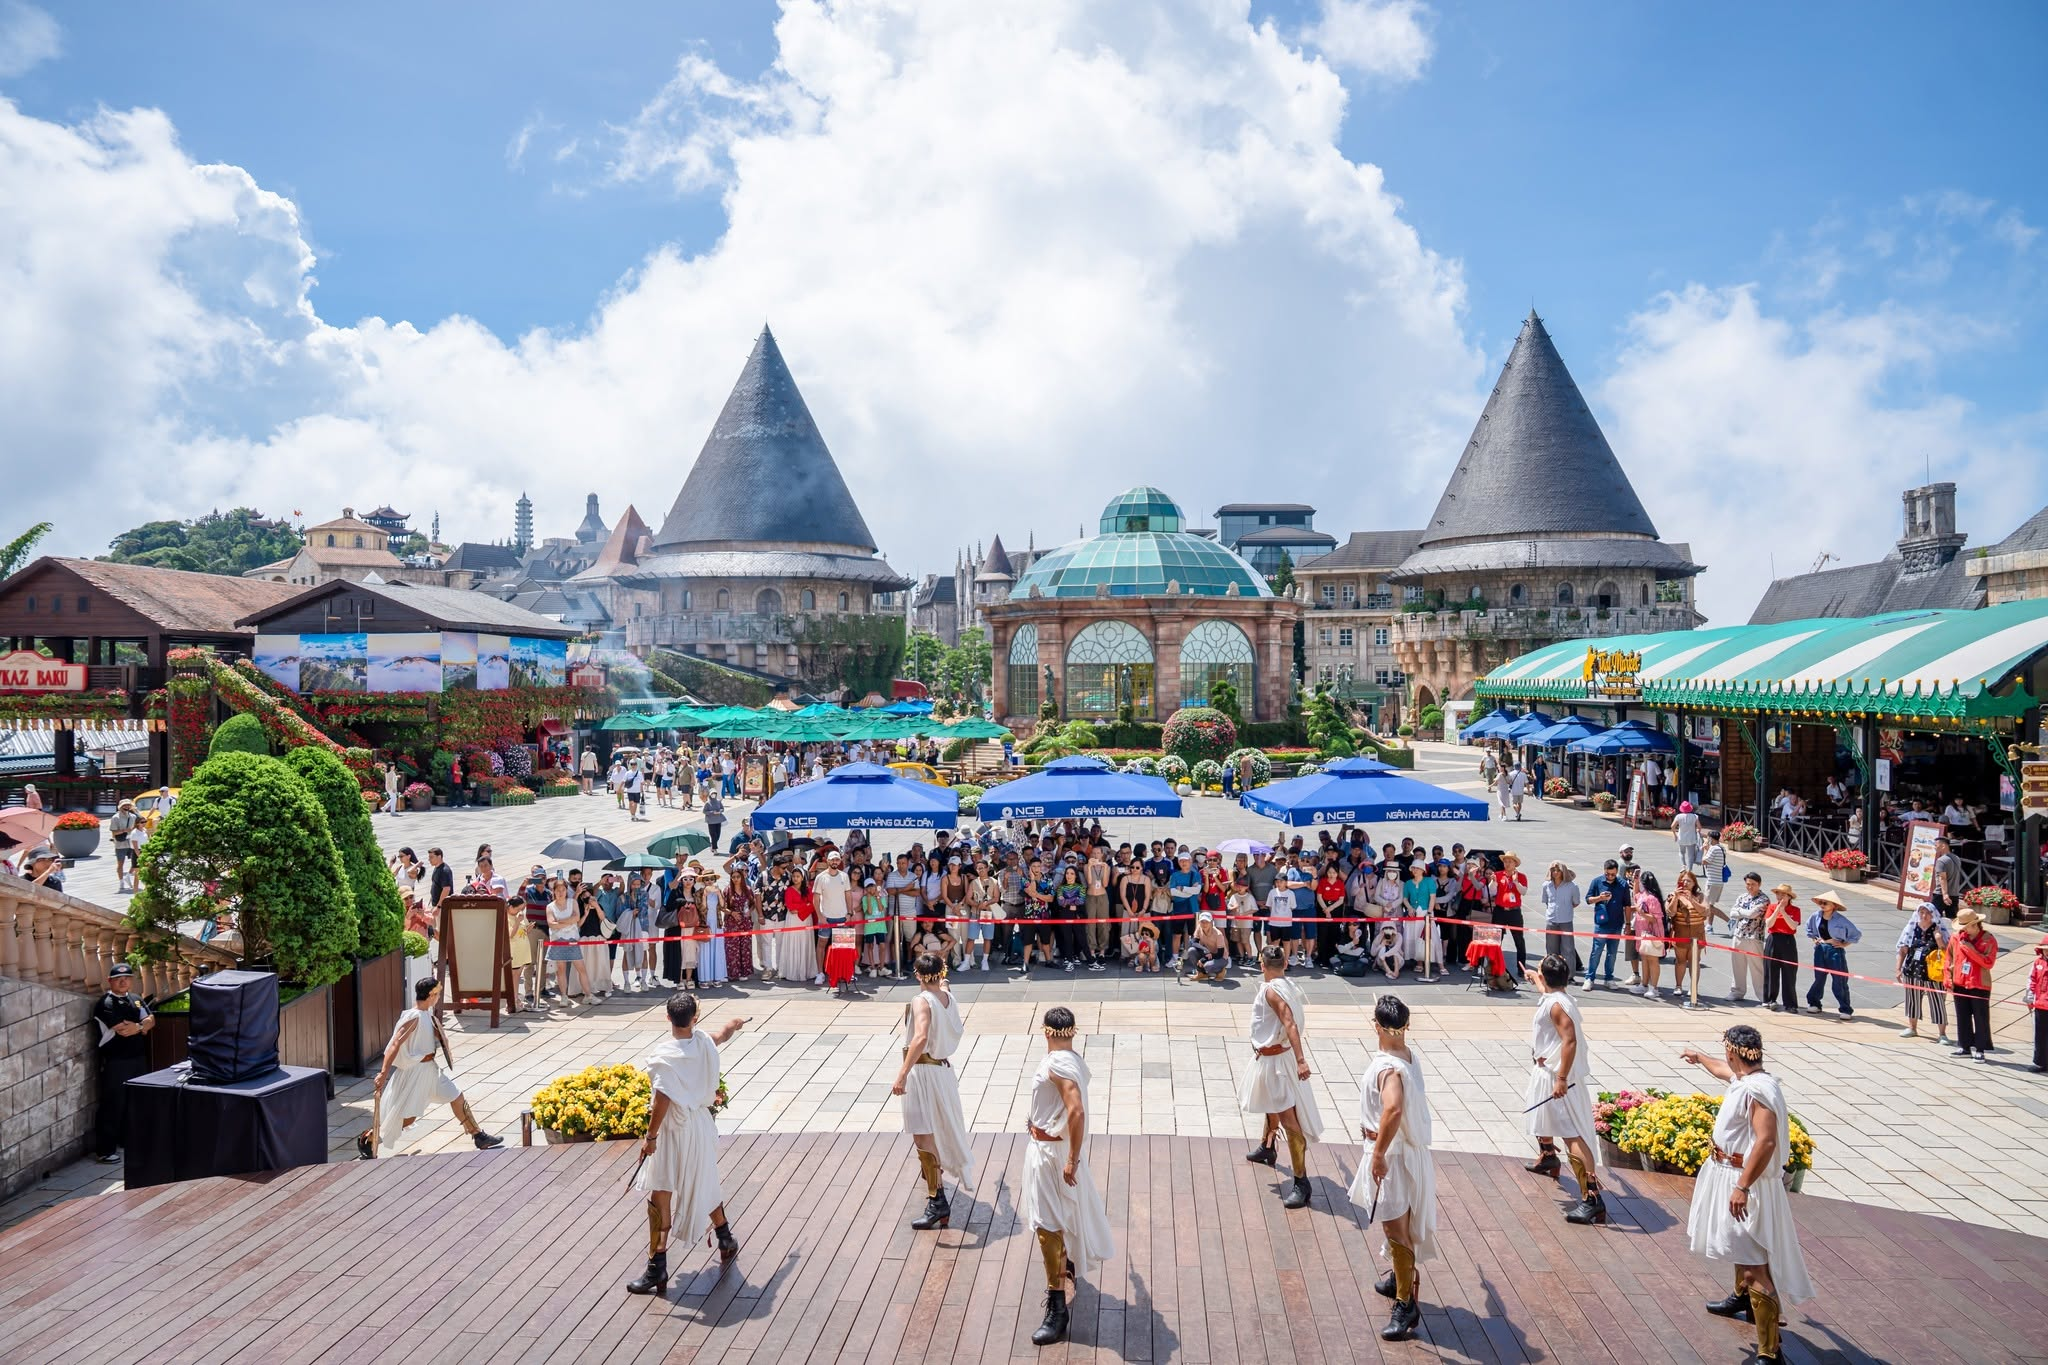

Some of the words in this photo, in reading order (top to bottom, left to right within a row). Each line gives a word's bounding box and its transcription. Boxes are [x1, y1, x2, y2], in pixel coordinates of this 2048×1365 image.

[0, 669, 29, 686] KAZ
[36, 669, 68, 687] BAKU
[1015, 806, 1044, 816] NCB
[1070, 805, 1093, 816] NGÂN
[1093, 805, 1116, 816] HÀNG
[1139, 805, 1157, 816] DÂN
[1326, 810, 1355, 821] NCB
[1386, 809, 1408, 820] NGÂN
[1408, 809, 1430, 820] HÀNG
[1453, 809, 1470, 819] DÂN
[788, 817, 818, 826] NCB
[847, 816, 869, 827] NGÂN
[870, 816, 893, 827] HÀNG
[916, 817, 934, 828] DÂN
